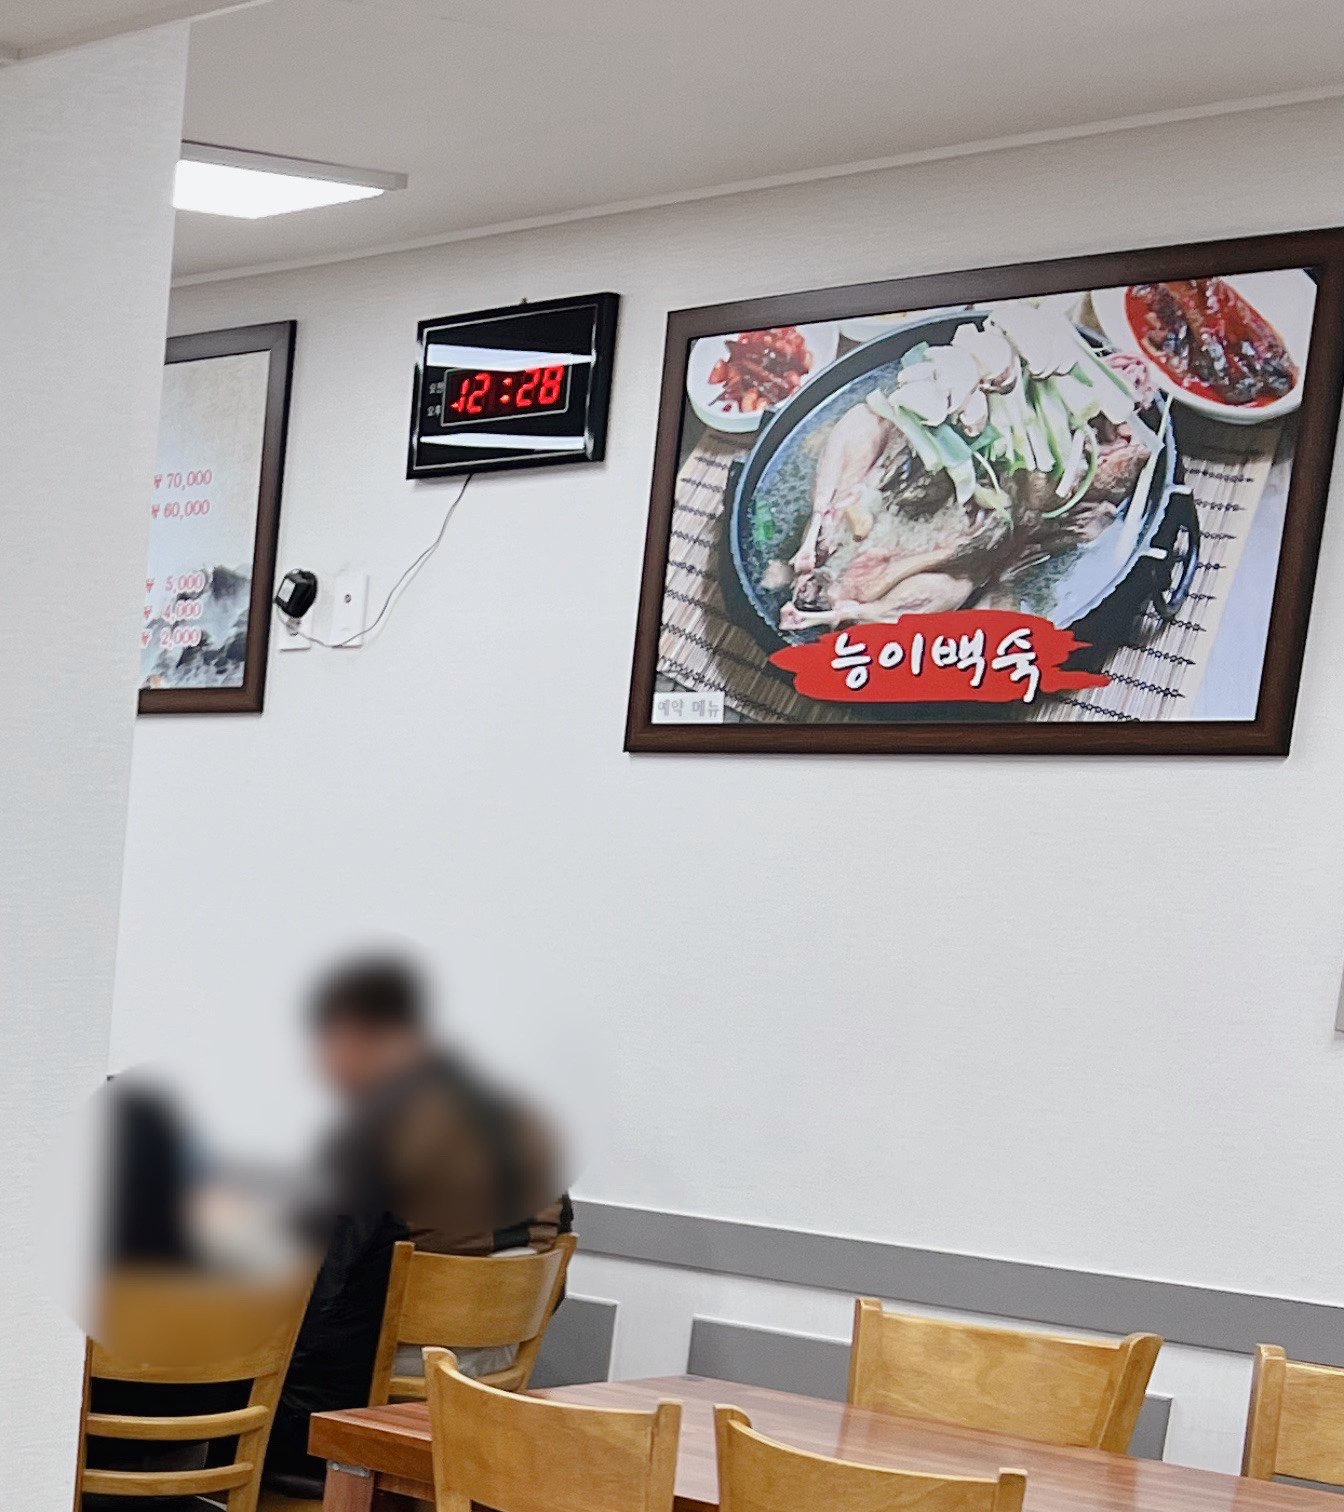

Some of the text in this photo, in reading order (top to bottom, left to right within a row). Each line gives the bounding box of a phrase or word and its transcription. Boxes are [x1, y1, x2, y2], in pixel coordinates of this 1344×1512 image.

[456, 365, 565, 414] 12:28
[167, 469, 212, 490] 70,000
[164, 499, 210, 519] 60,000
[165, 574, 203, 593] 5,000
[162, 629, 200, 649] 2,000
[830, 628, 1040, 704] 능이백숙
[657, 699, 720, 718] 예약 메뉴
